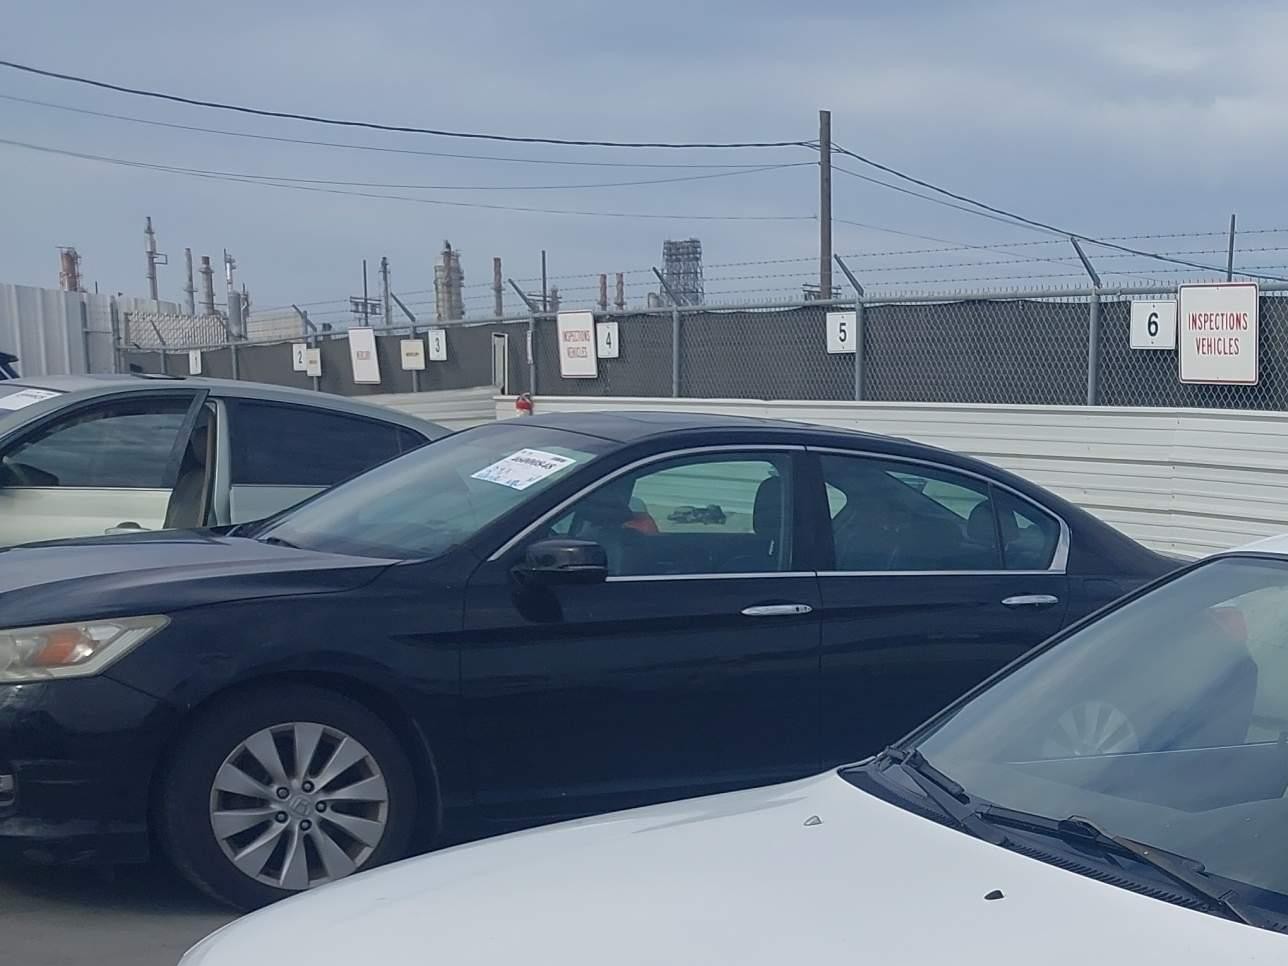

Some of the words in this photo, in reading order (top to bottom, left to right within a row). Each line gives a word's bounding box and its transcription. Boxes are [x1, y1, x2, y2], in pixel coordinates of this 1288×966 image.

[1147, 312, 1159, 337] 6
[1188, 312, 1248, 331] INSPECTIONS
[605, 331, 612, 349] 4
[839, 322, 847, 342] 5
[434, 337, 441, 353] 3
[1195, 337, 1240, 355] VEHICLES
[297, 350, 303, 364] 2
